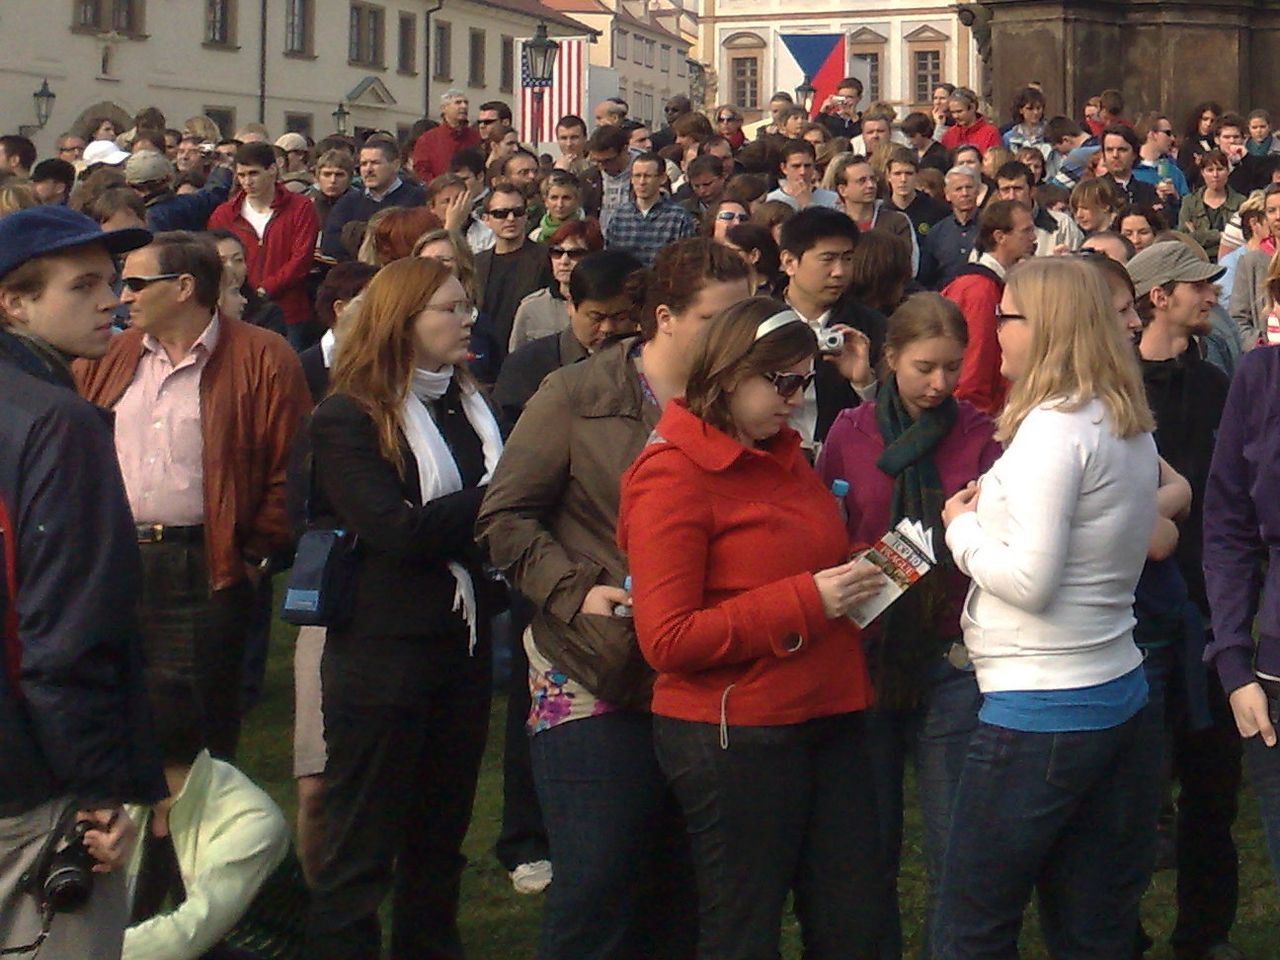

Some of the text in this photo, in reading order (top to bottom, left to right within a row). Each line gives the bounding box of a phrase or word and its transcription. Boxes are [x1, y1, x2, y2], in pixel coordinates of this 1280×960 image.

[881, 545, 915, 577] PRAGUE
[893, 540, 912, 558] TOP
[908, 554, 922, 568] 10
